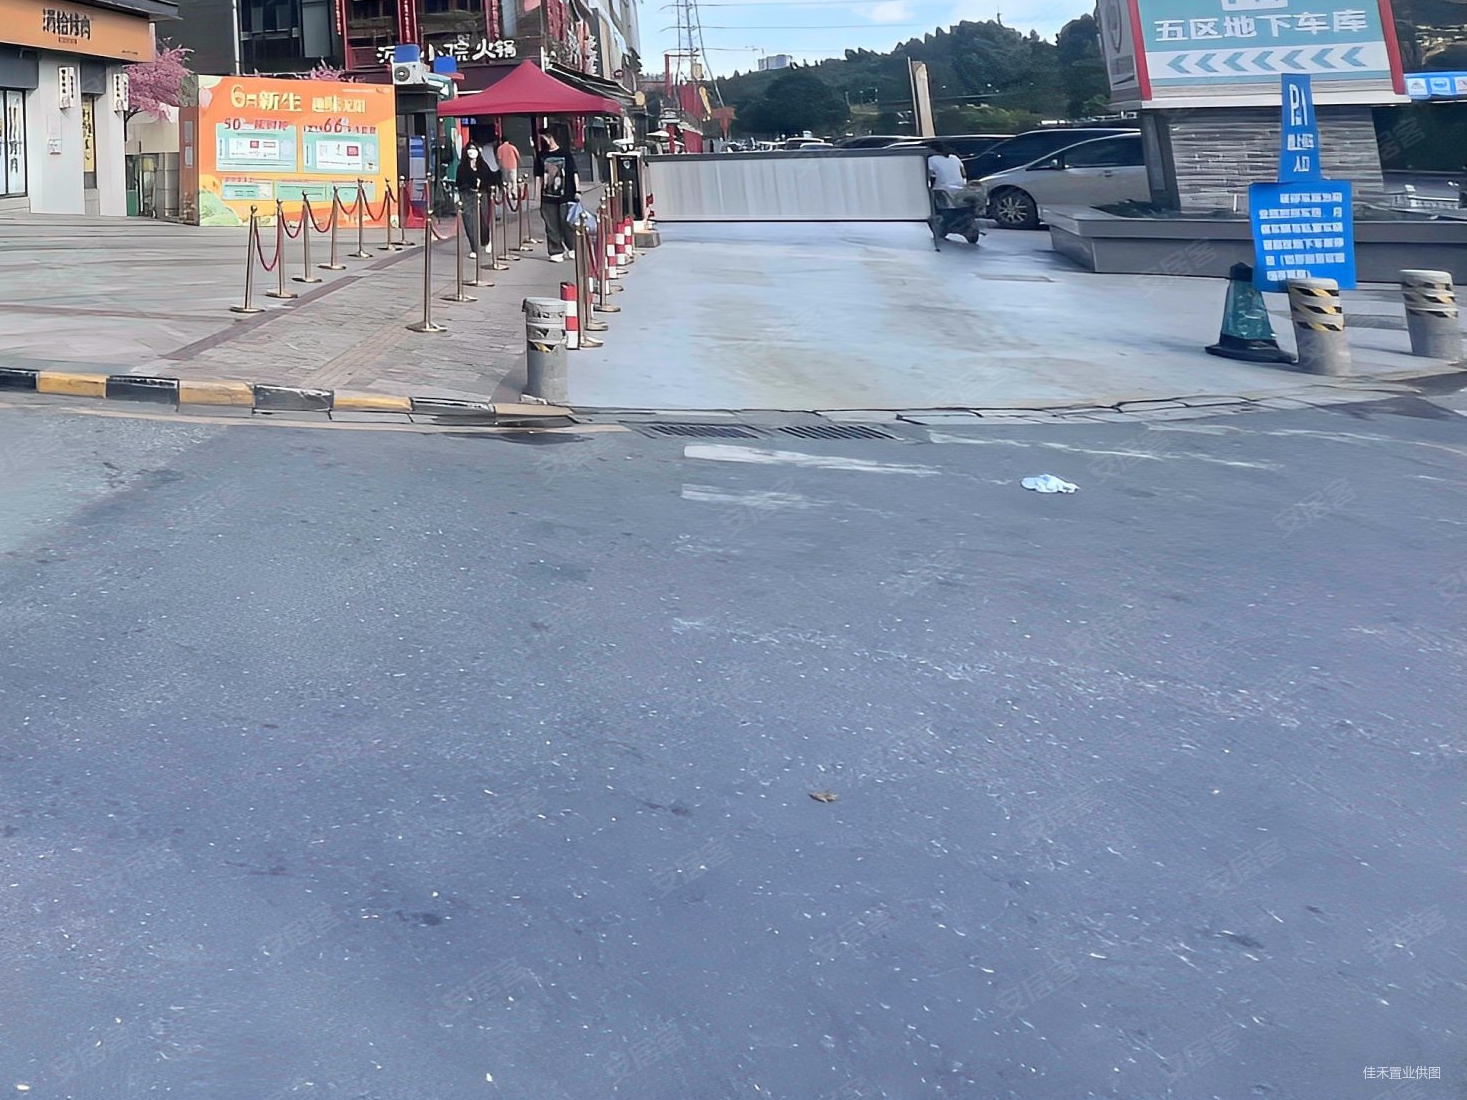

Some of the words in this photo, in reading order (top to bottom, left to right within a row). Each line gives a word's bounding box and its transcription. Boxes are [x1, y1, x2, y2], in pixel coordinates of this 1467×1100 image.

[1154, 8, 1368, 42] 五区地下车库
[376, 38, 516, 63] 小院火锅
